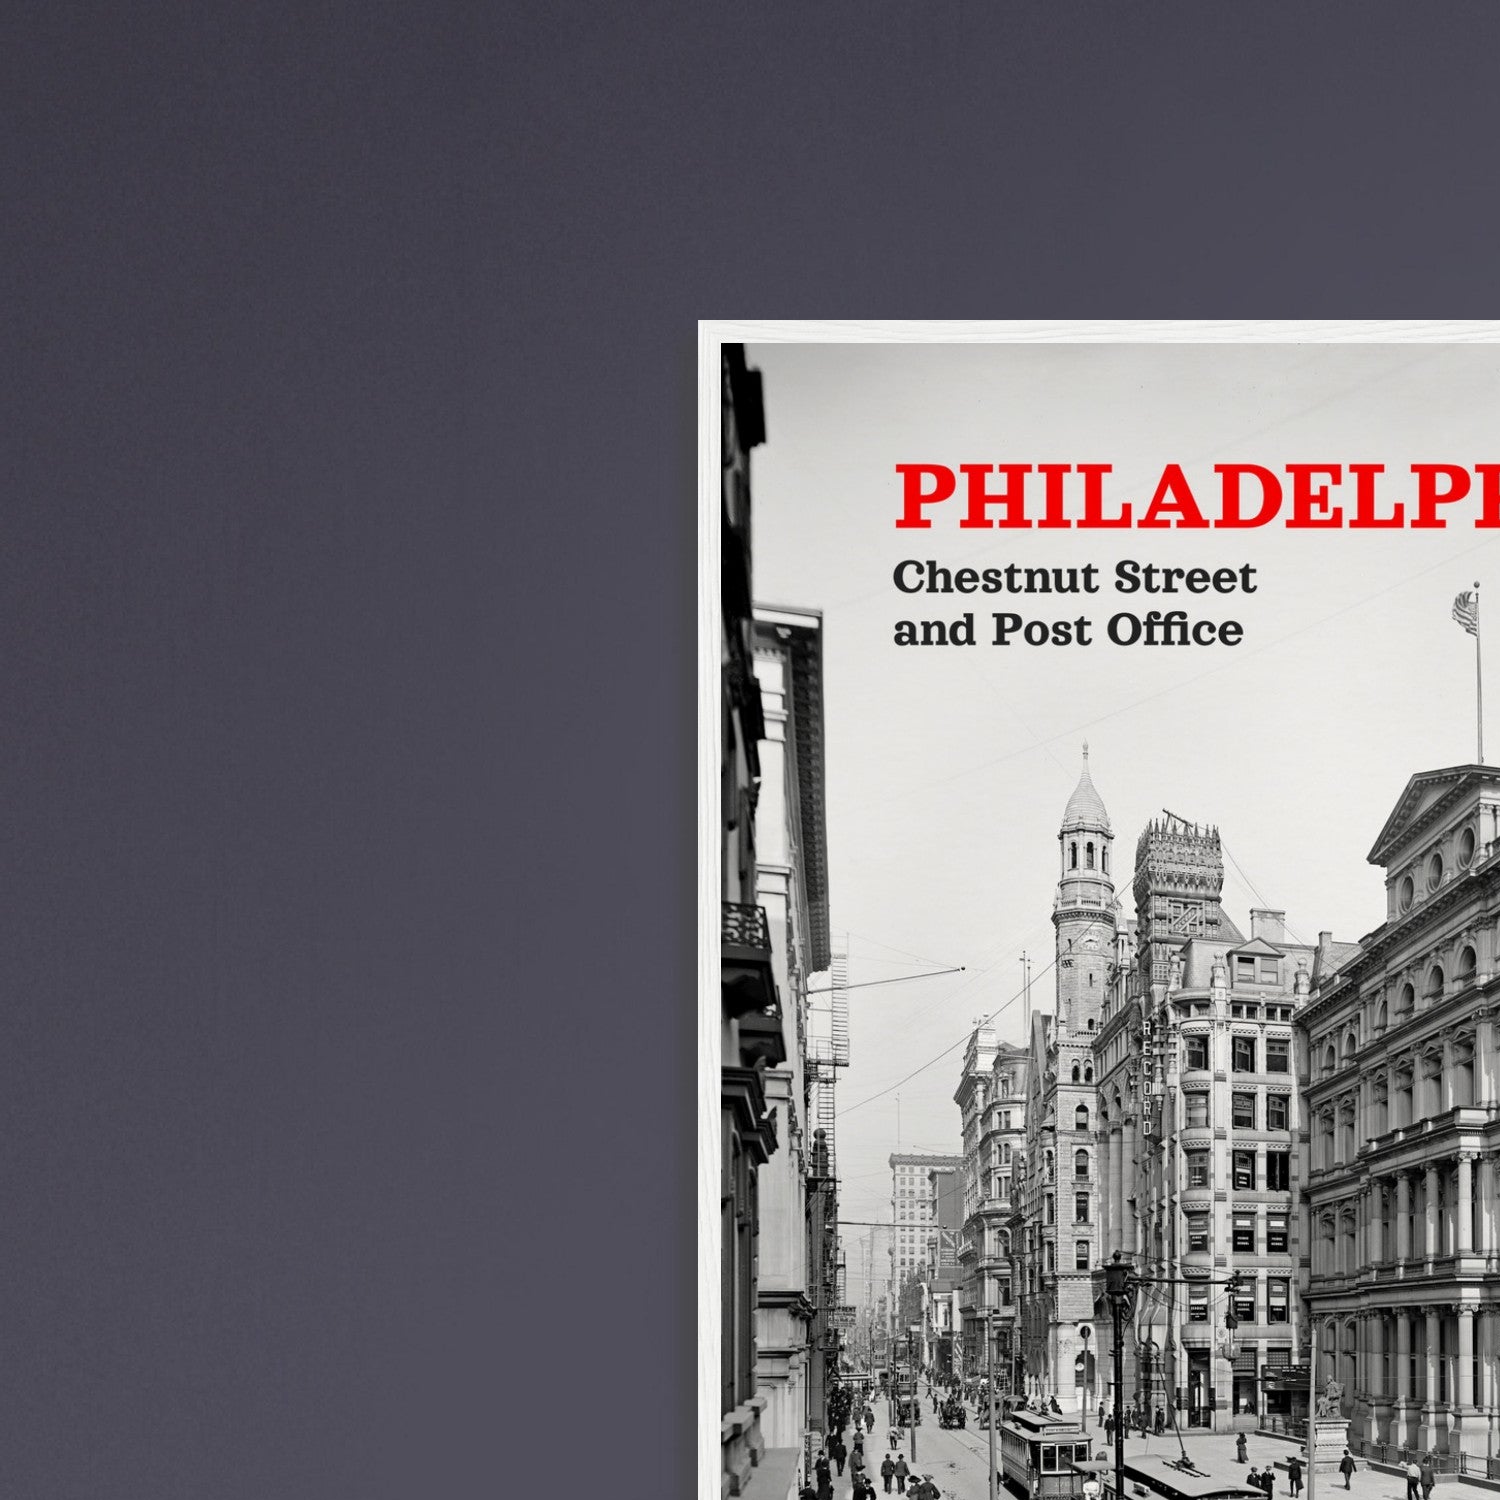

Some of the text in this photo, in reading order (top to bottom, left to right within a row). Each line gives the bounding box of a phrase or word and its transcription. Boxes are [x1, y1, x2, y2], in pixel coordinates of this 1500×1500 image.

[893, 559, 1258, 594] Chestnut Street
[893, 610, 1244, 647] and Post Office
[1142, 1020, 1152, 1136] RECORD
